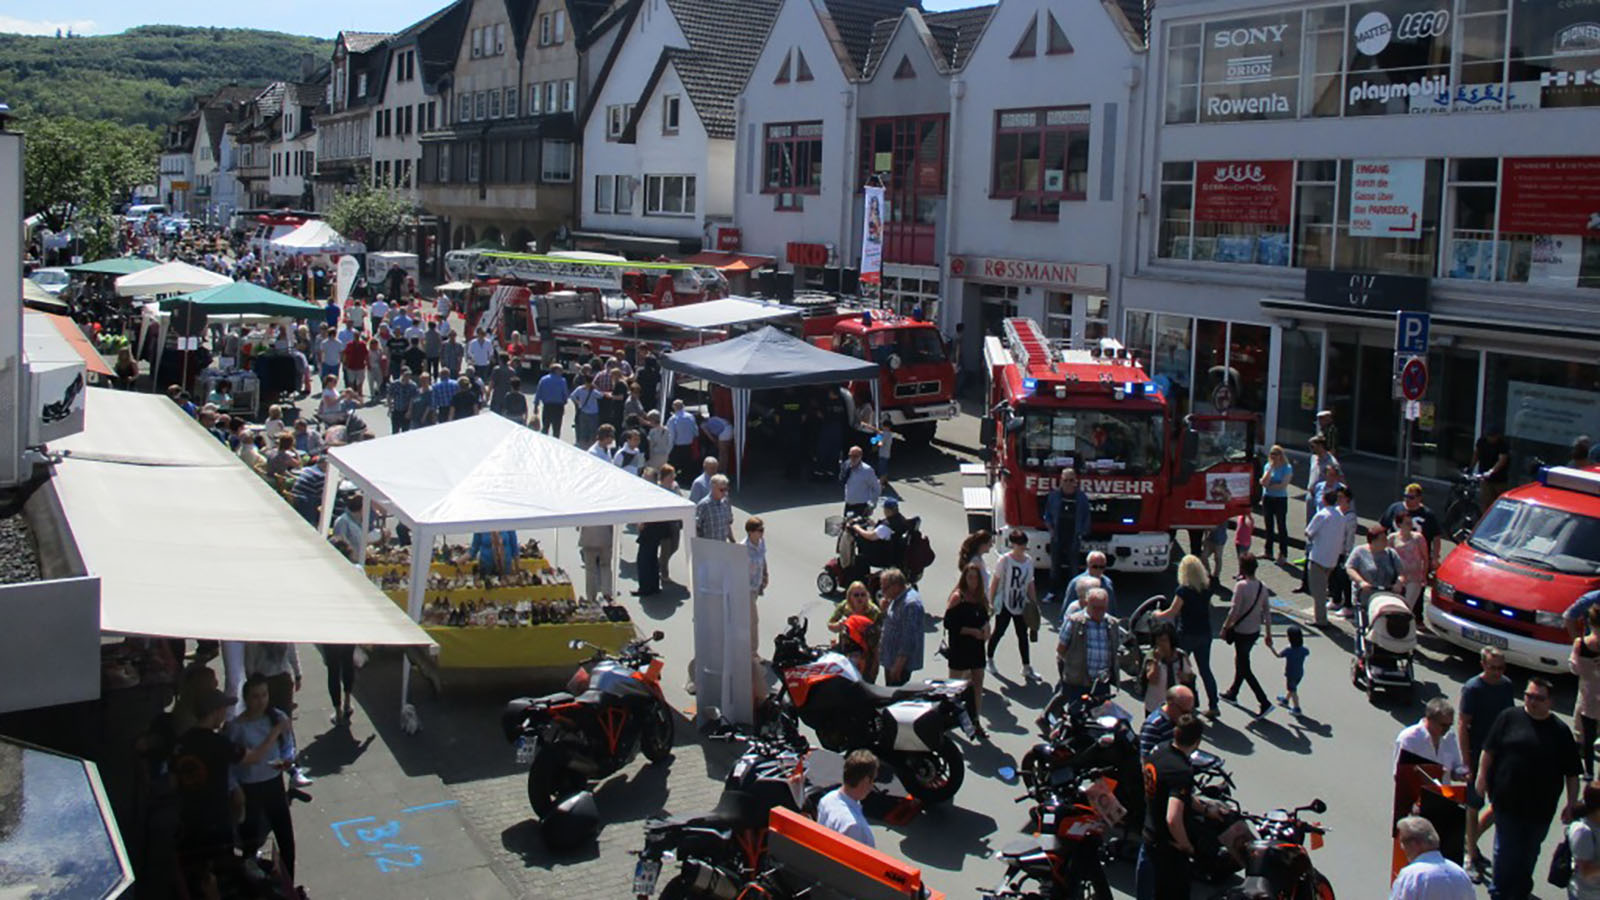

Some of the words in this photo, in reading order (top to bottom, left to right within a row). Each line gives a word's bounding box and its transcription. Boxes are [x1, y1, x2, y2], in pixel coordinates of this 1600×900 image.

[1213, 24, 1288, 49] SONY
[1355, 23, 1393, 44] MATTEL
[1397, 9, 1450, 40] LEGO
[1226, 62, 1272, 77] ORION
[1350, 74, 1447, 106] playmobil
[1207, 93, 1290, 116] Rowenta
[985, 259, 1078, 284] ROSSMANN
[1404, 318, 1423, 348] P
[1025, 475, 1155, 494] FEURWEHR
